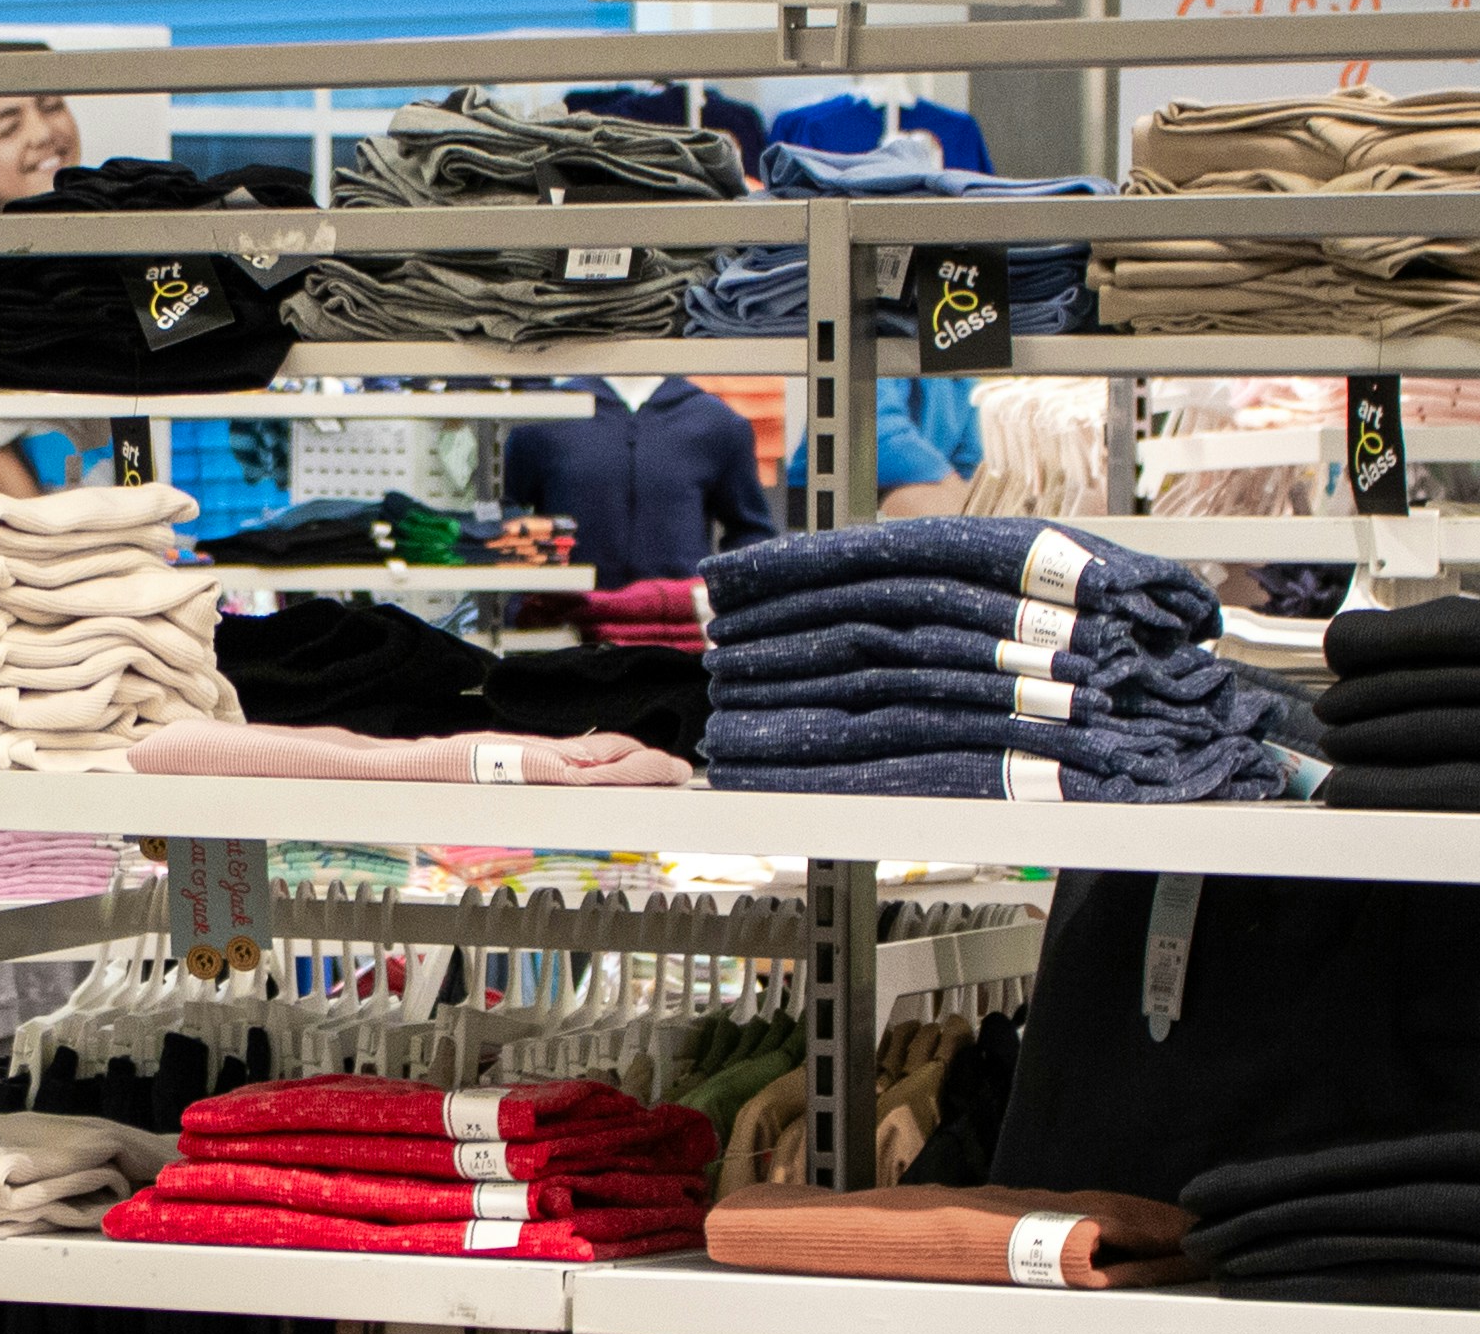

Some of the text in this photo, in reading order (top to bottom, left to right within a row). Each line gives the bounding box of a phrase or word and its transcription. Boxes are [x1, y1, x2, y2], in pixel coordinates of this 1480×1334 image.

[146, 261, 182, 280] art
[939, 260, 979, 287] art
[156, 282, 210, 330] class
[935, 304, 998, 350] class
[1358, 400, 1383, 429] art
[123, 441, 140, 467] art
[1358, 448, 1397, 492] class
